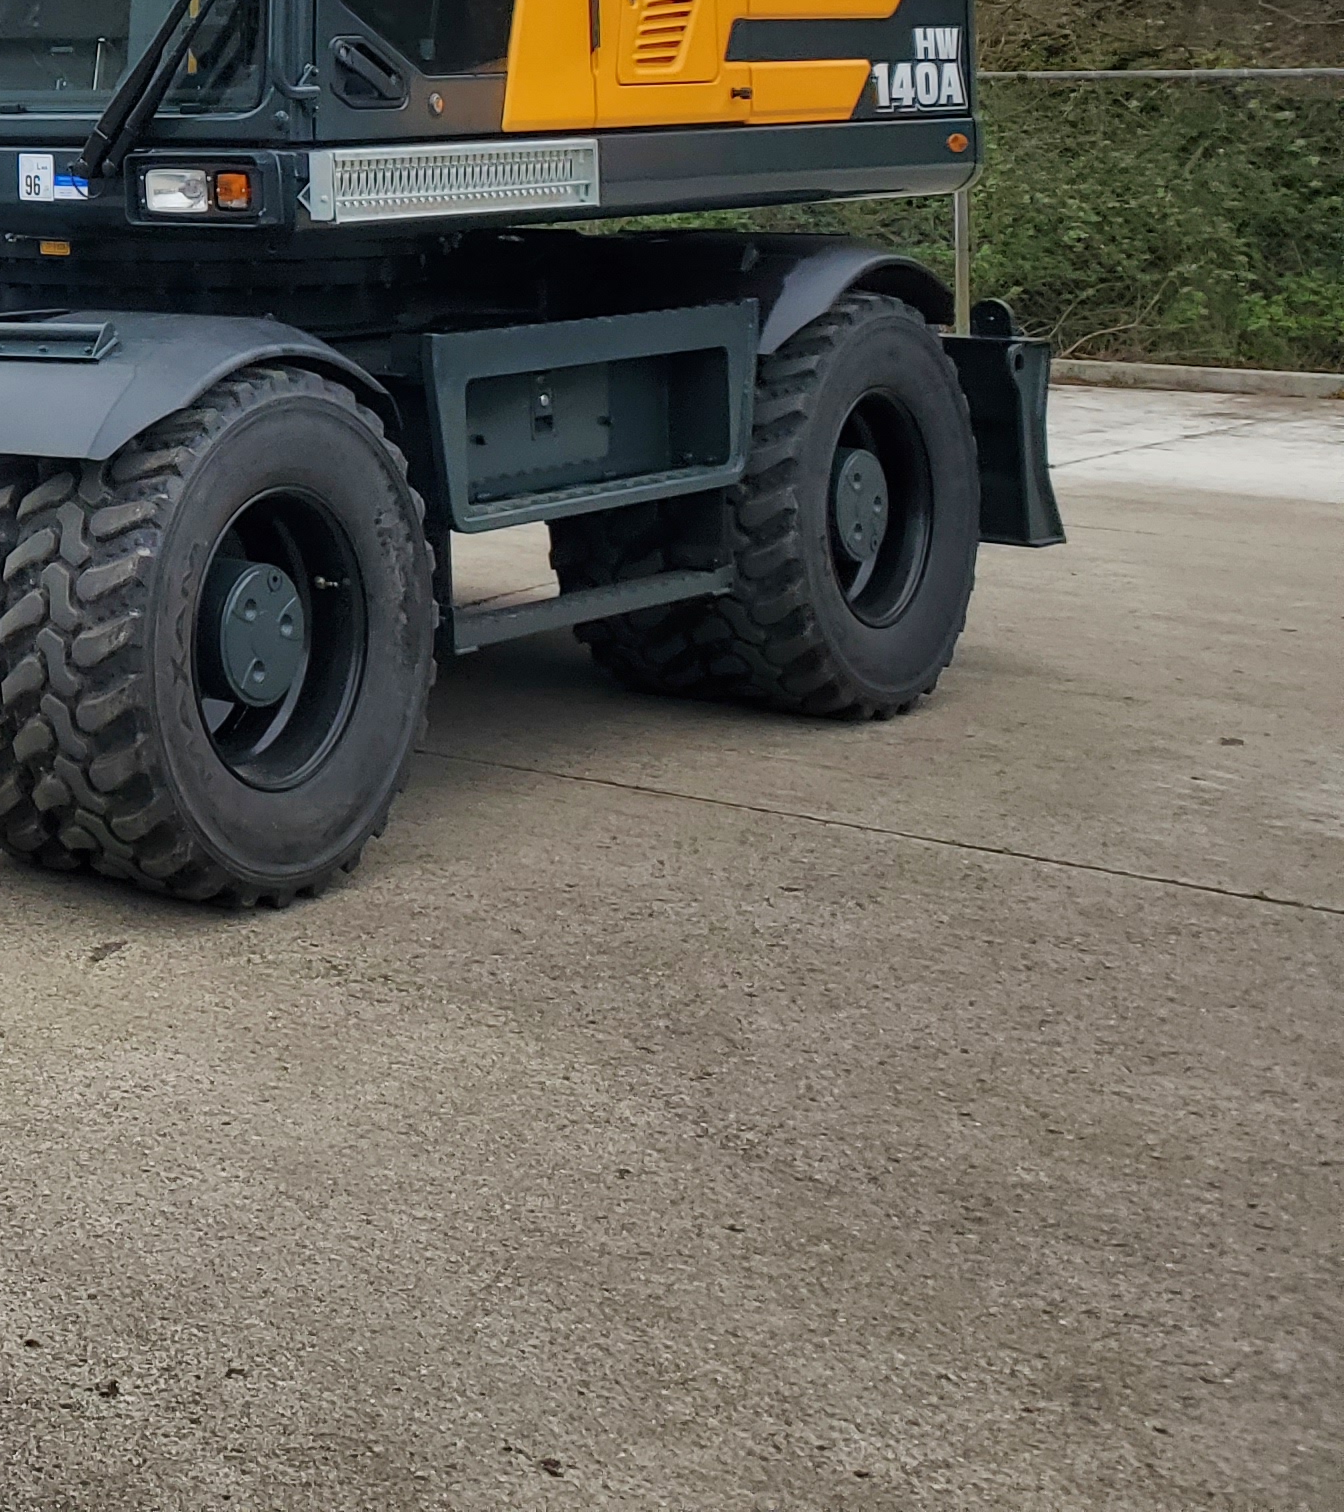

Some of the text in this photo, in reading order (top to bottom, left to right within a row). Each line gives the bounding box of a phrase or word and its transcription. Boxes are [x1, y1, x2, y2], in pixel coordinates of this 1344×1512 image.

[913, 27, 960, 60] HW
[872, 61, 965, 107] 140A
[25, 174, 41, 196] 96
